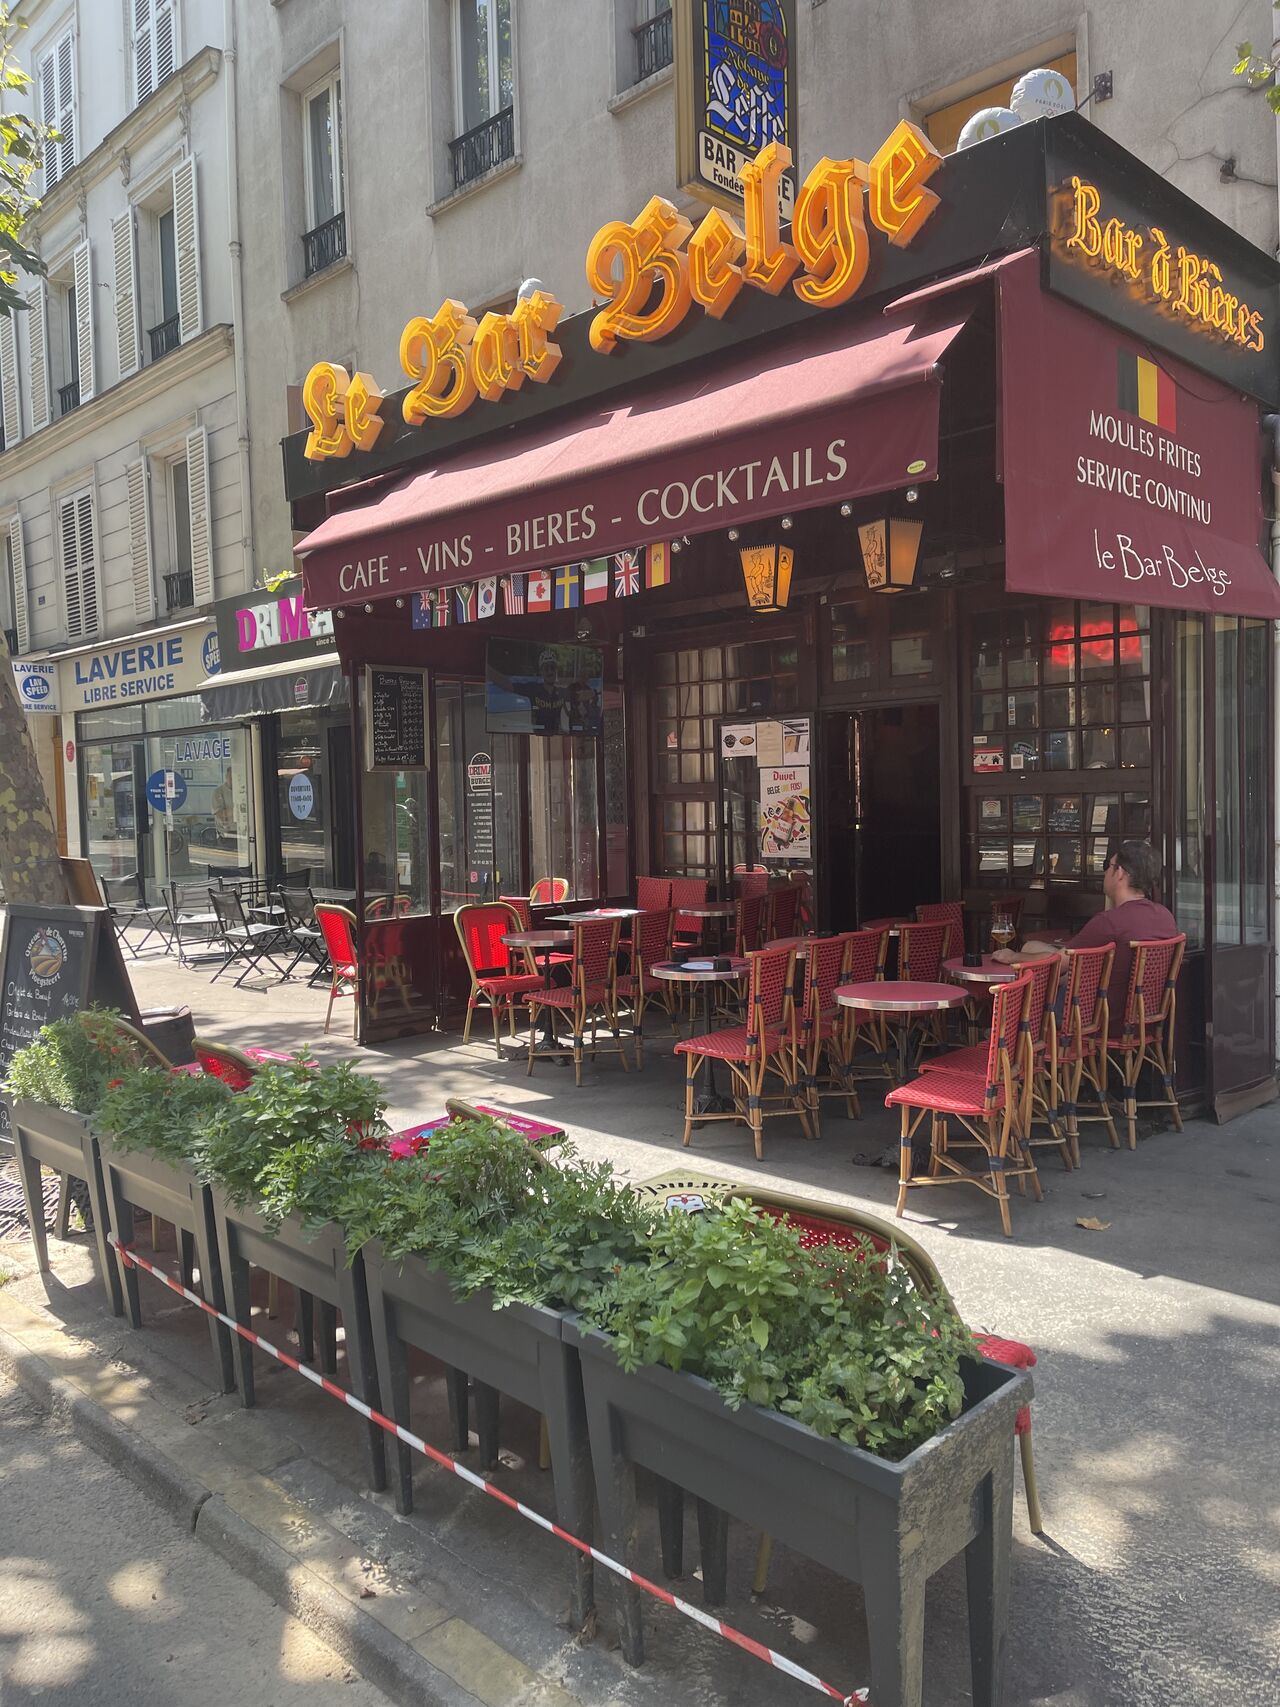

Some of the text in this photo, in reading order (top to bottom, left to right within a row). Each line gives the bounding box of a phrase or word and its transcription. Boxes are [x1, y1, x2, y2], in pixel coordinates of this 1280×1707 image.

[706, 62, 787, 148] Leffe
[704, 136, 736, 174] BAR
[1067, 176, 1143, 279] Bar
[1151, 228, 1172, 299] à
[303, 119, 943, 461] Le Bar Belge
[1089, 409, 1201, 478] MOULES FRITES
[1077, 456, 1211, 525] SERVICE CONTINU
[339, 555, 389, 592] CAFE
[417, 535, 473, 575] VINS
[507, 504, 596, 555] BIERES
[637, 439, 848, 526] COCKTAILS
[14, 664, 54, 673] LAVERIE
[75, 637, 184, 685] LAVERIE
[205, 650, 221, 670] SPEE
[26, 685, 48, 696] SPEED
[84, 674, 174, 704] LIBRE SERVICE
[176, 738, 231, 762] LAVAGE
[773, 770, 796, 780] Duvel
